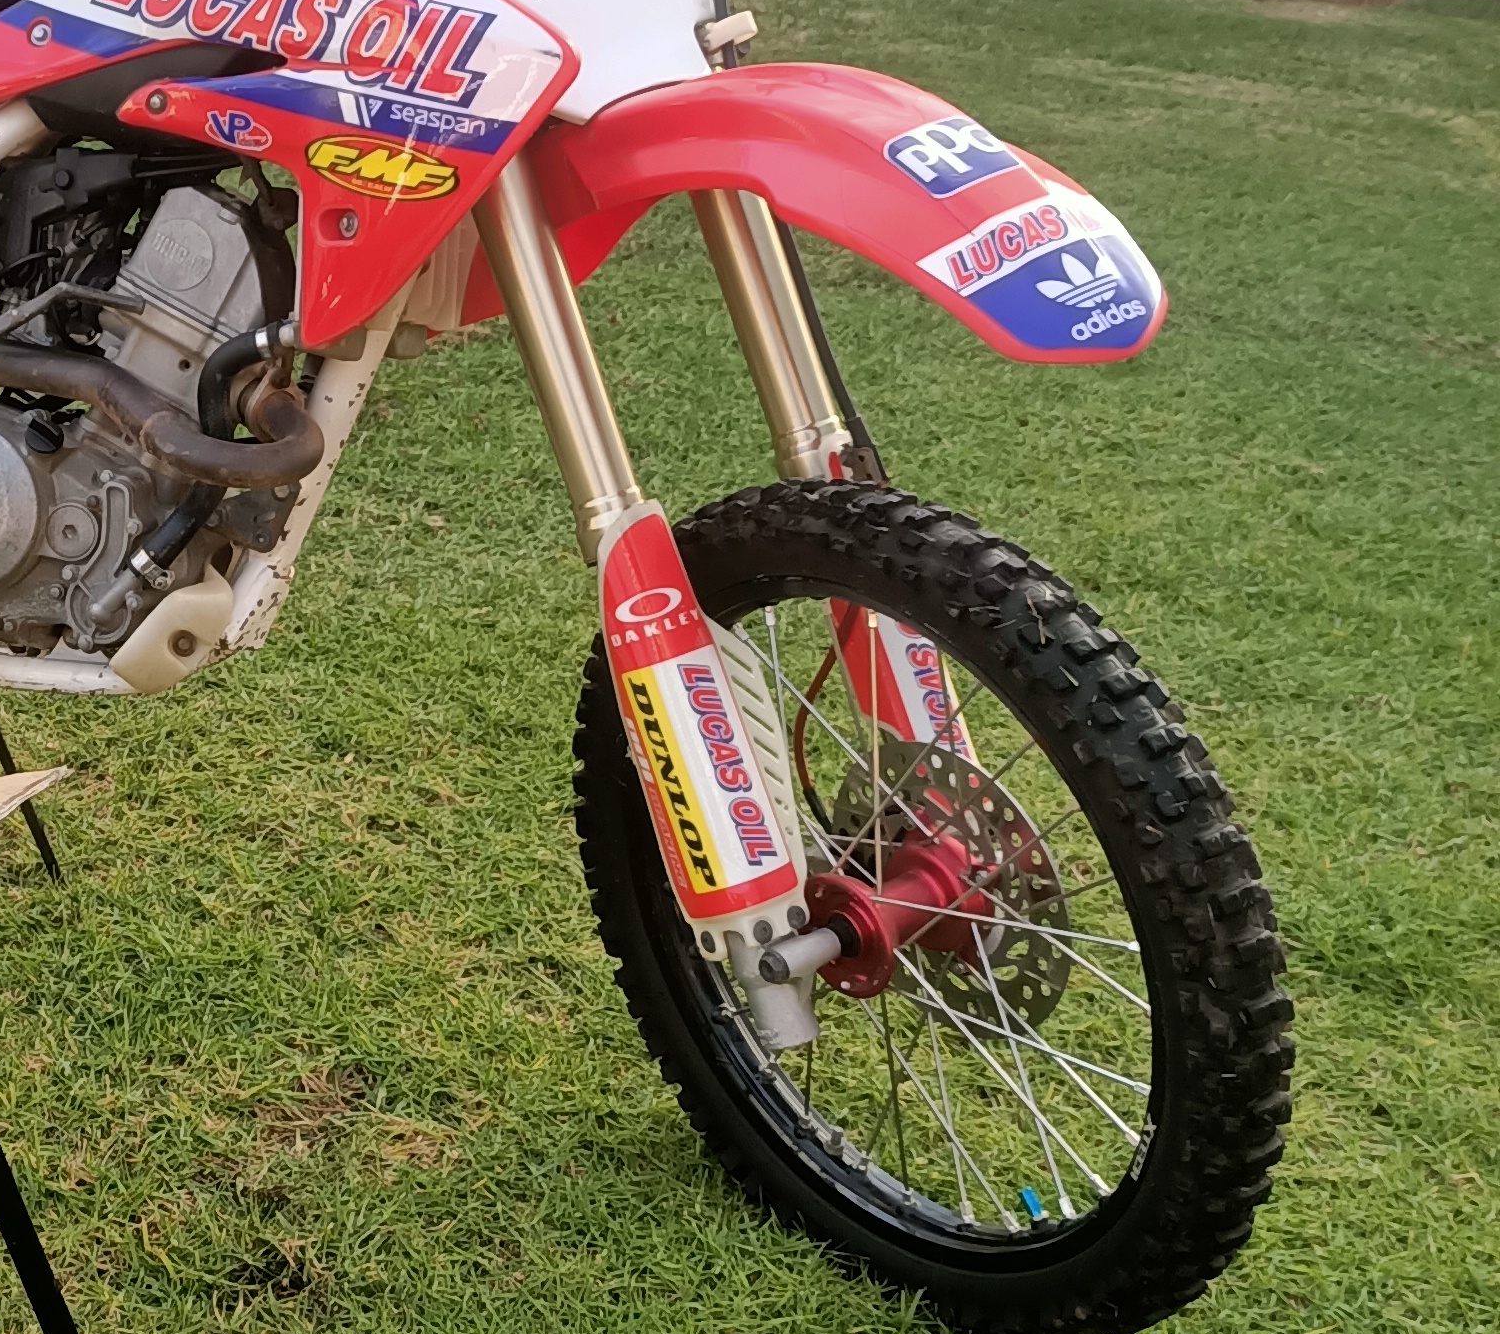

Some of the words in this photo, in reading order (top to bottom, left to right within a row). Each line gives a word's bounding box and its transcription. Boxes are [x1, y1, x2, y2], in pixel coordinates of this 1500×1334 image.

[389, 103, 487, 137] seaspan
[309, 142, 456, 189] FMF
[946, 204, 1069, 293] LUCAS
[1070, 298, 1147, 341] adidas
[610, 607, 701, 648] OAKLEY
[628, 677, 717, 888] DUNLOP
[676, 663, 753, 793] LUCAS
[728, 797, 778, 867] OIL
